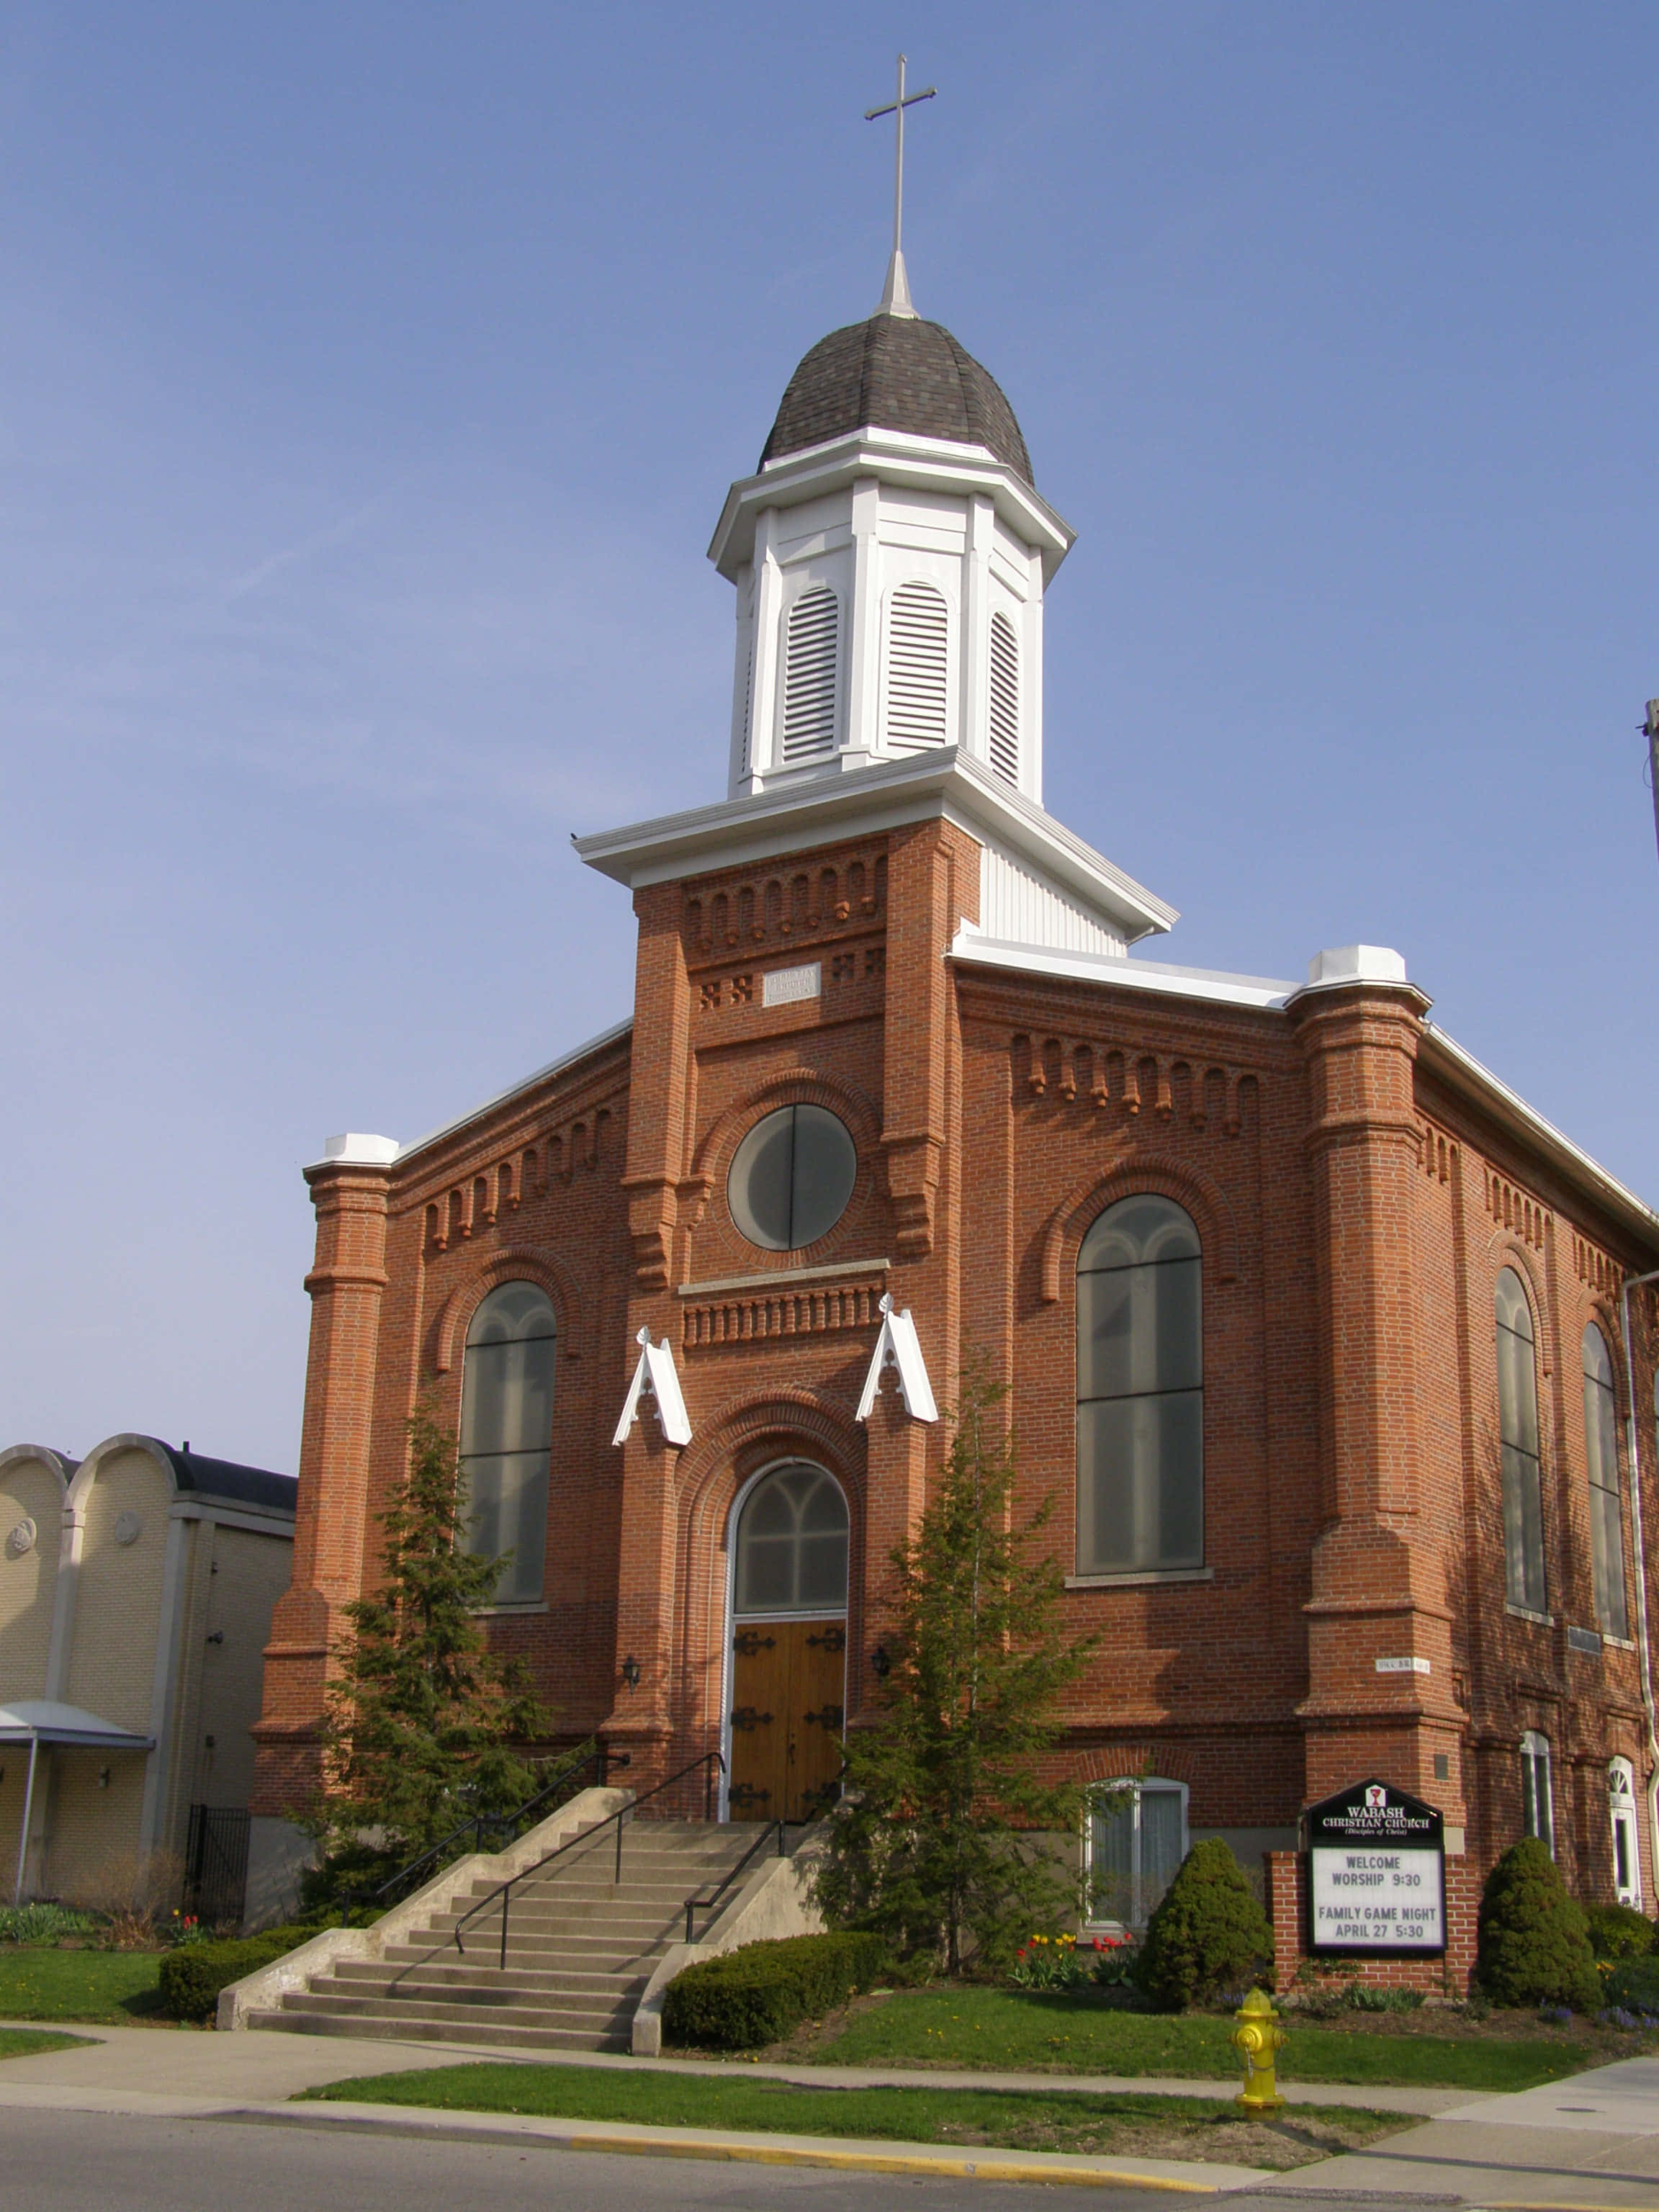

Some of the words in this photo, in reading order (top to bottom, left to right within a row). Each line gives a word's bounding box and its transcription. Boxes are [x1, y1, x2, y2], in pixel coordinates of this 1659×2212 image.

[1348, 1807, 1404, 1818] WABASH
[1323, 1817, 1381, 1827] CHRISTIAN
[1385, 1819, 1429, 1828] CHURCH
[1346, 1856, 1401, 1869] WELCOME
[1332, 1872, 1385, 1886] WORSHIP
[1393, 1873, 1421, 1887] 9:30
[1318, 1907, 1360, 1920] FAMILY
[1364, 1907, 1397, 1920] GAME
[1402, 1907, 1436, 1921] NIGHT
[1336, 1925, 1370, 1938] APRIL
[1373, 1925, 1387, 1937] 27
[1395, 1925, 1424, 1938] 5:30
